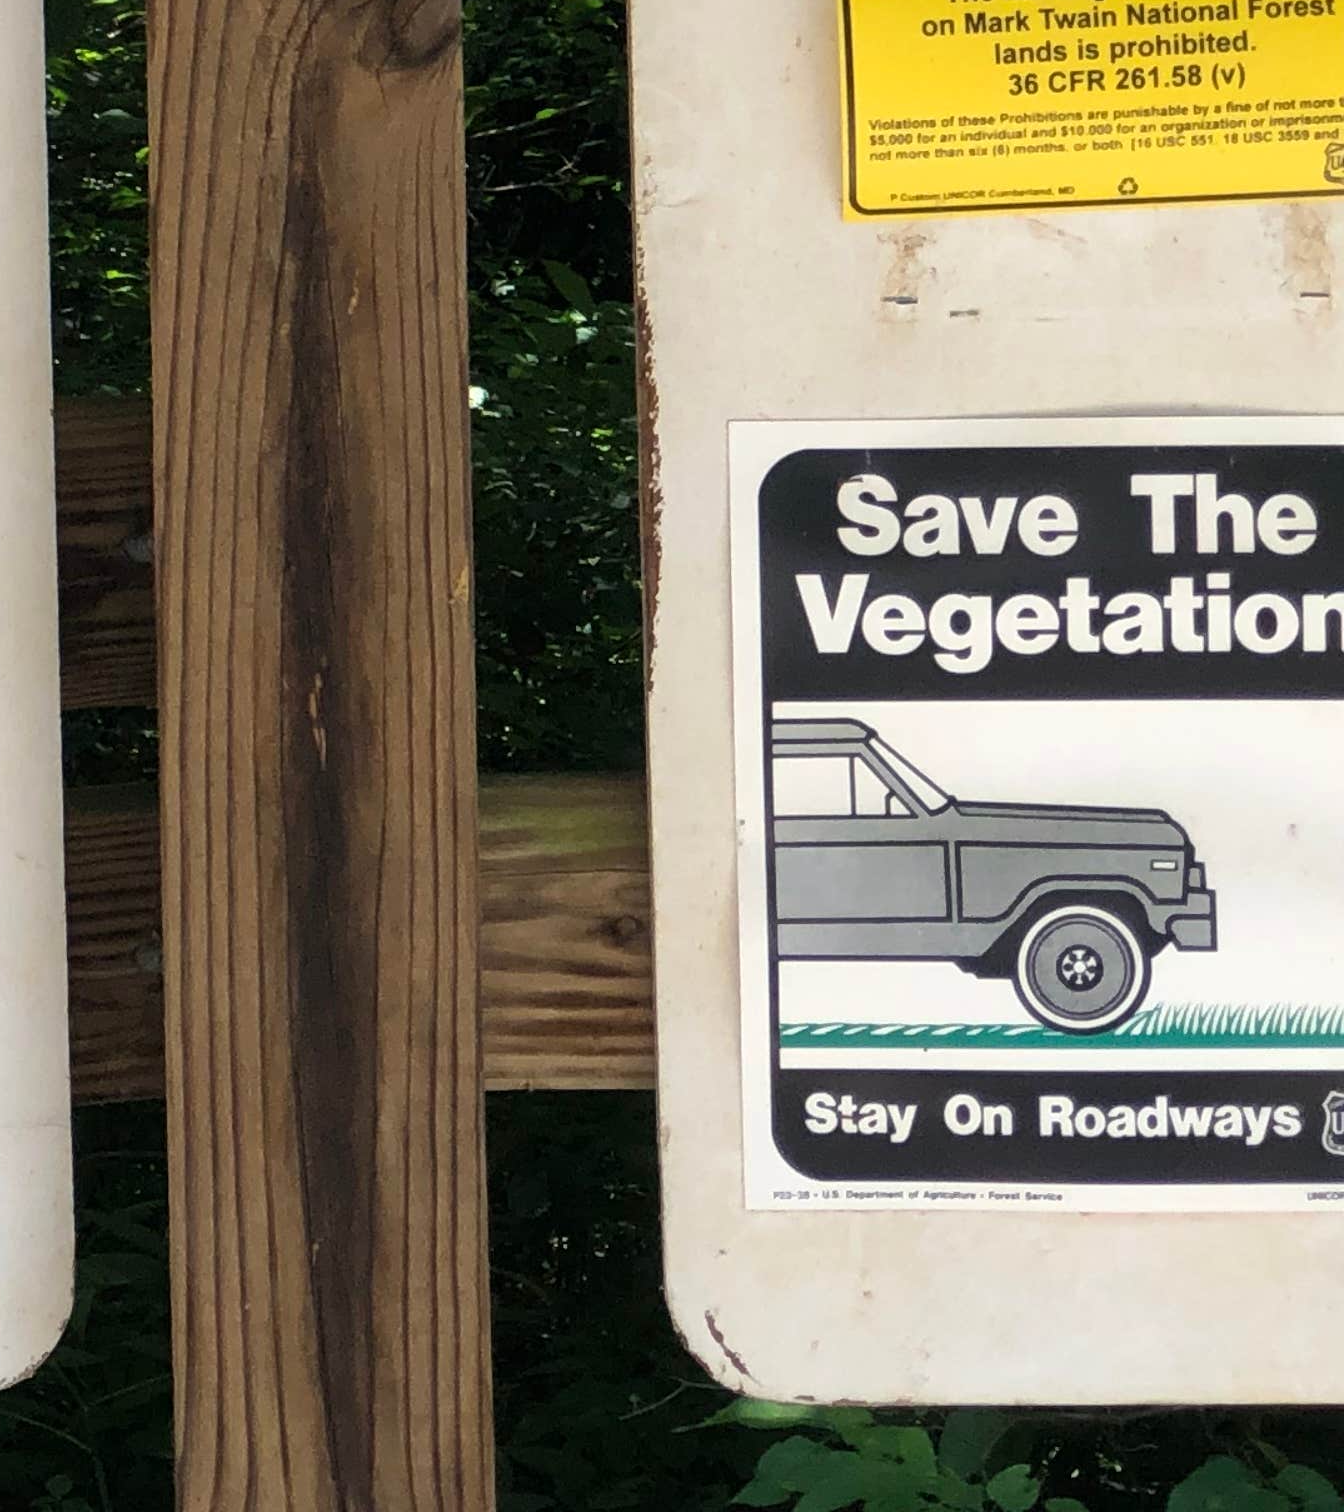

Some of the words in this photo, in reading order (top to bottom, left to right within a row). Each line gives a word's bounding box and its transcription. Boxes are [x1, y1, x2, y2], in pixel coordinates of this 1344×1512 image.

[921, 16, 957, 38] on
[964, 9, 1031, 35] Mark
[1038, 5, 1118, 31] Twain
[1125, 0, 1240, 28] National
[994, 39, 1069, 66] lands
[1076, 38, 1100, 62] is
[1108, 29, 1258, 70] prohibited.
[1007, 72, 1039, 97] 36
[1047, 68, 1106, 94] CFR
[1114, 62, 1203, 90] 261.58
[1210, 61, 1247, 91] (v)
[867, 116, 937, 132] Violations
[940, 114, 955, 128] of
[958, 113, 996, 128] these
[999, 109, 1084, 126] Prohibitions
[1087, 109, 1109, 122] are
[1113, 104, 1189, 121] punishable
[1193, 102, 1210, 117] by
[1214, 104, 1222, 115] a
[1225, 99, 1252, 114] fine
[1255, 97, 1270, 112] of
[1273, 97, 1296, 112] not
[1299, 96, 1336, 111] more
[835, 472, 1080, 559] Save
[1129, 472, 1319, 558] The
[794, 571, 1344, 675] Vegetation
[804, 1090, 918, 1144] Stay
[943, 1093, 1014, 1138] On
[1038, 1094, 1304, 1144] Roadways
[845, 1189, 904, 1202] Department
[908, 1190, 920, 1200] of
[923, 1190, 977, 1202] Agriculture
[988, 1190, 1021, 1202] Forest
[1025, 1191, 1063, 1202] Service
